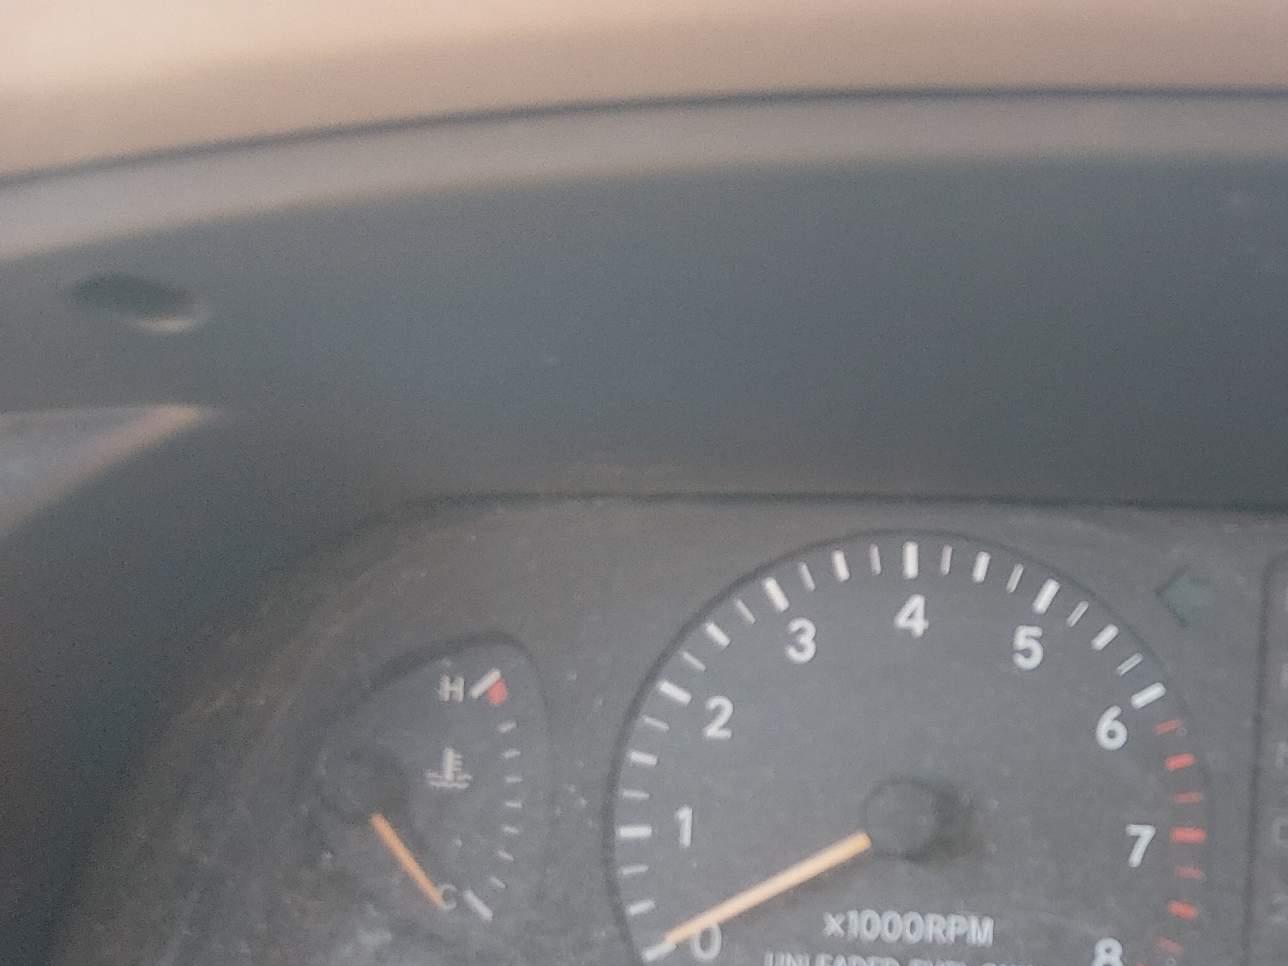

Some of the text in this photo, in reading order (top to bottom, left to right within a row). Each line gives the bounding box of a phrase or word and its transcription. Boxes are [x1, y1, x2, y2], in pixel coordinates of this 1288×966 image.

[895, 595, 929, 637] 4
[786, 619, 817, 663] 3
[1013, 626, 1044, 669] 5
[438, 673, 465, 702] H
[706, 696, 733, 739] 2
[1096, 706, 1127, 750] 6
[677, 806, 693, 847] 1
[1126, 824, 1155, 867] 7
[691, 924, 722, 961] 0
